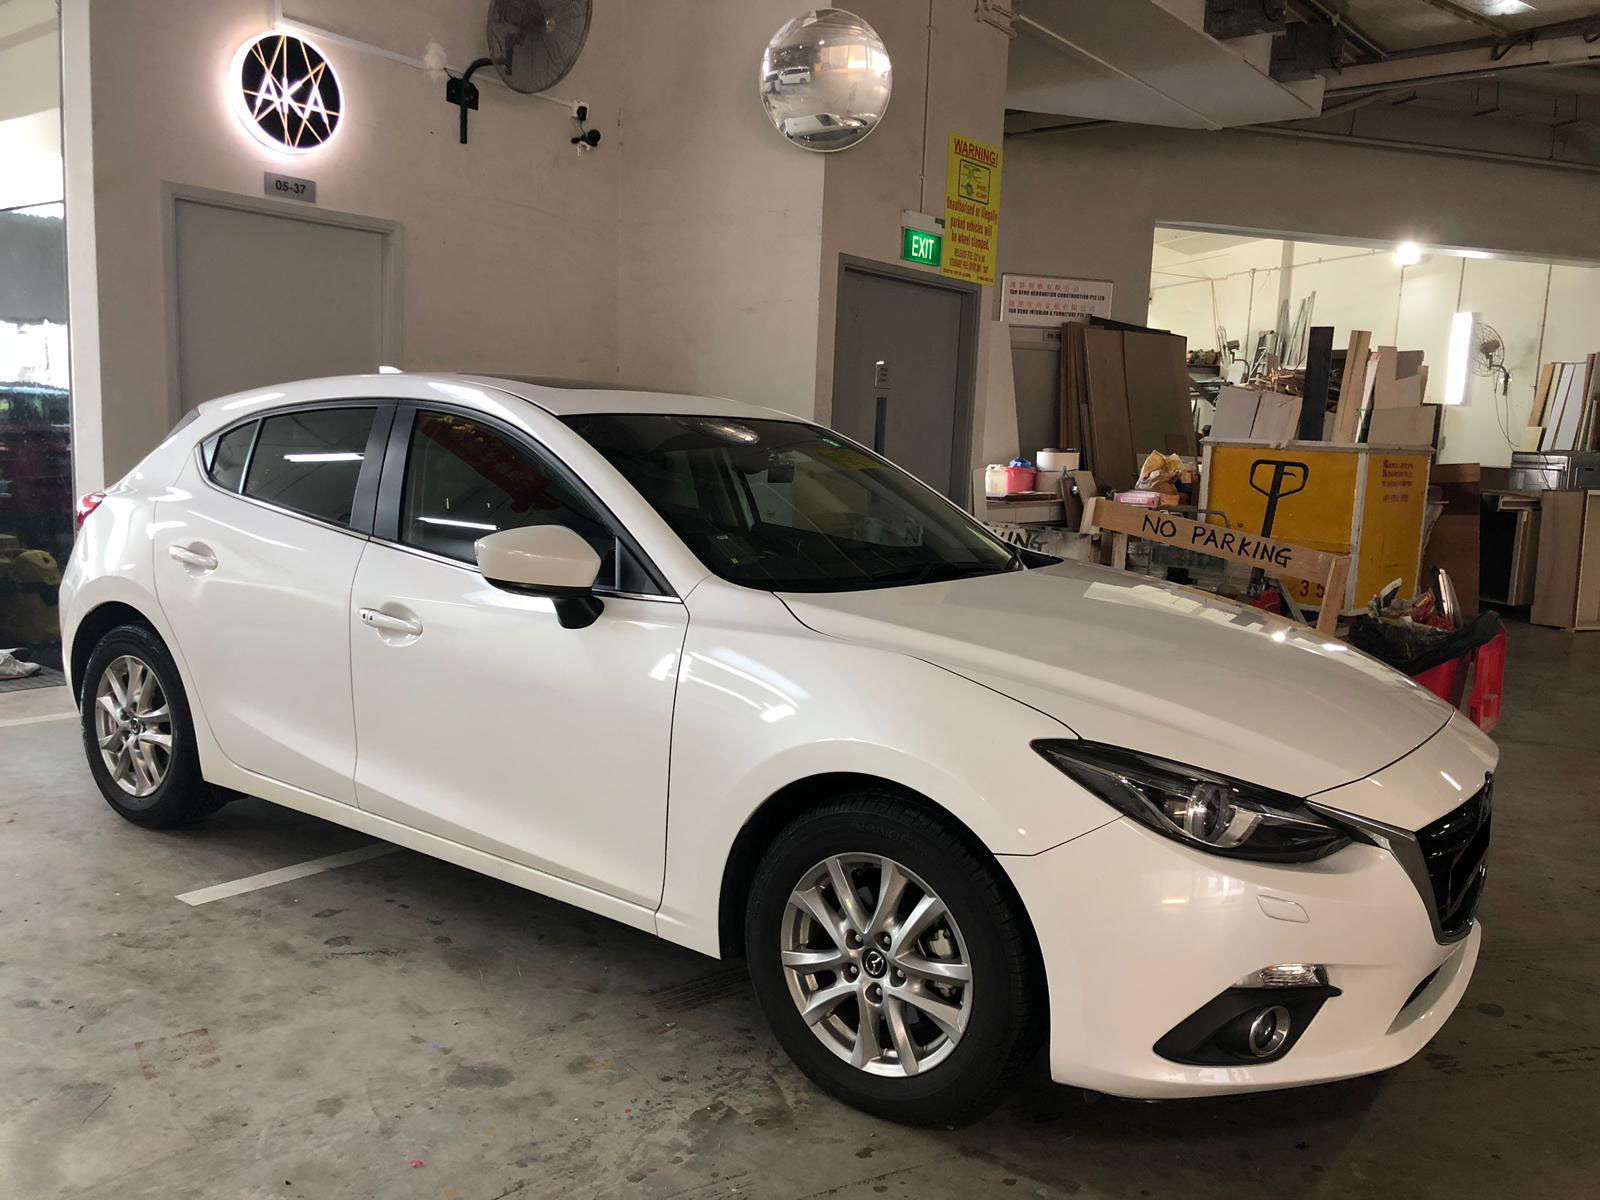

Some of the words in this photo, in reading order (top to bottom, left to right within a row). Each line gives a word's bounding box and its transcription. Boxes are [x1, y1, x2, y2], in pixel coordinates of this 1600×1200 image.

[255, 71, 329, 124] AKA
[954, 138, 999, 166] WARNING!
[275, 180, 307, 195] 05-37
[912, 235, 935, 260] EXIT
[1142, 514, 1177, 538] NO
[1191, 526, 1293, 568] PARKING
